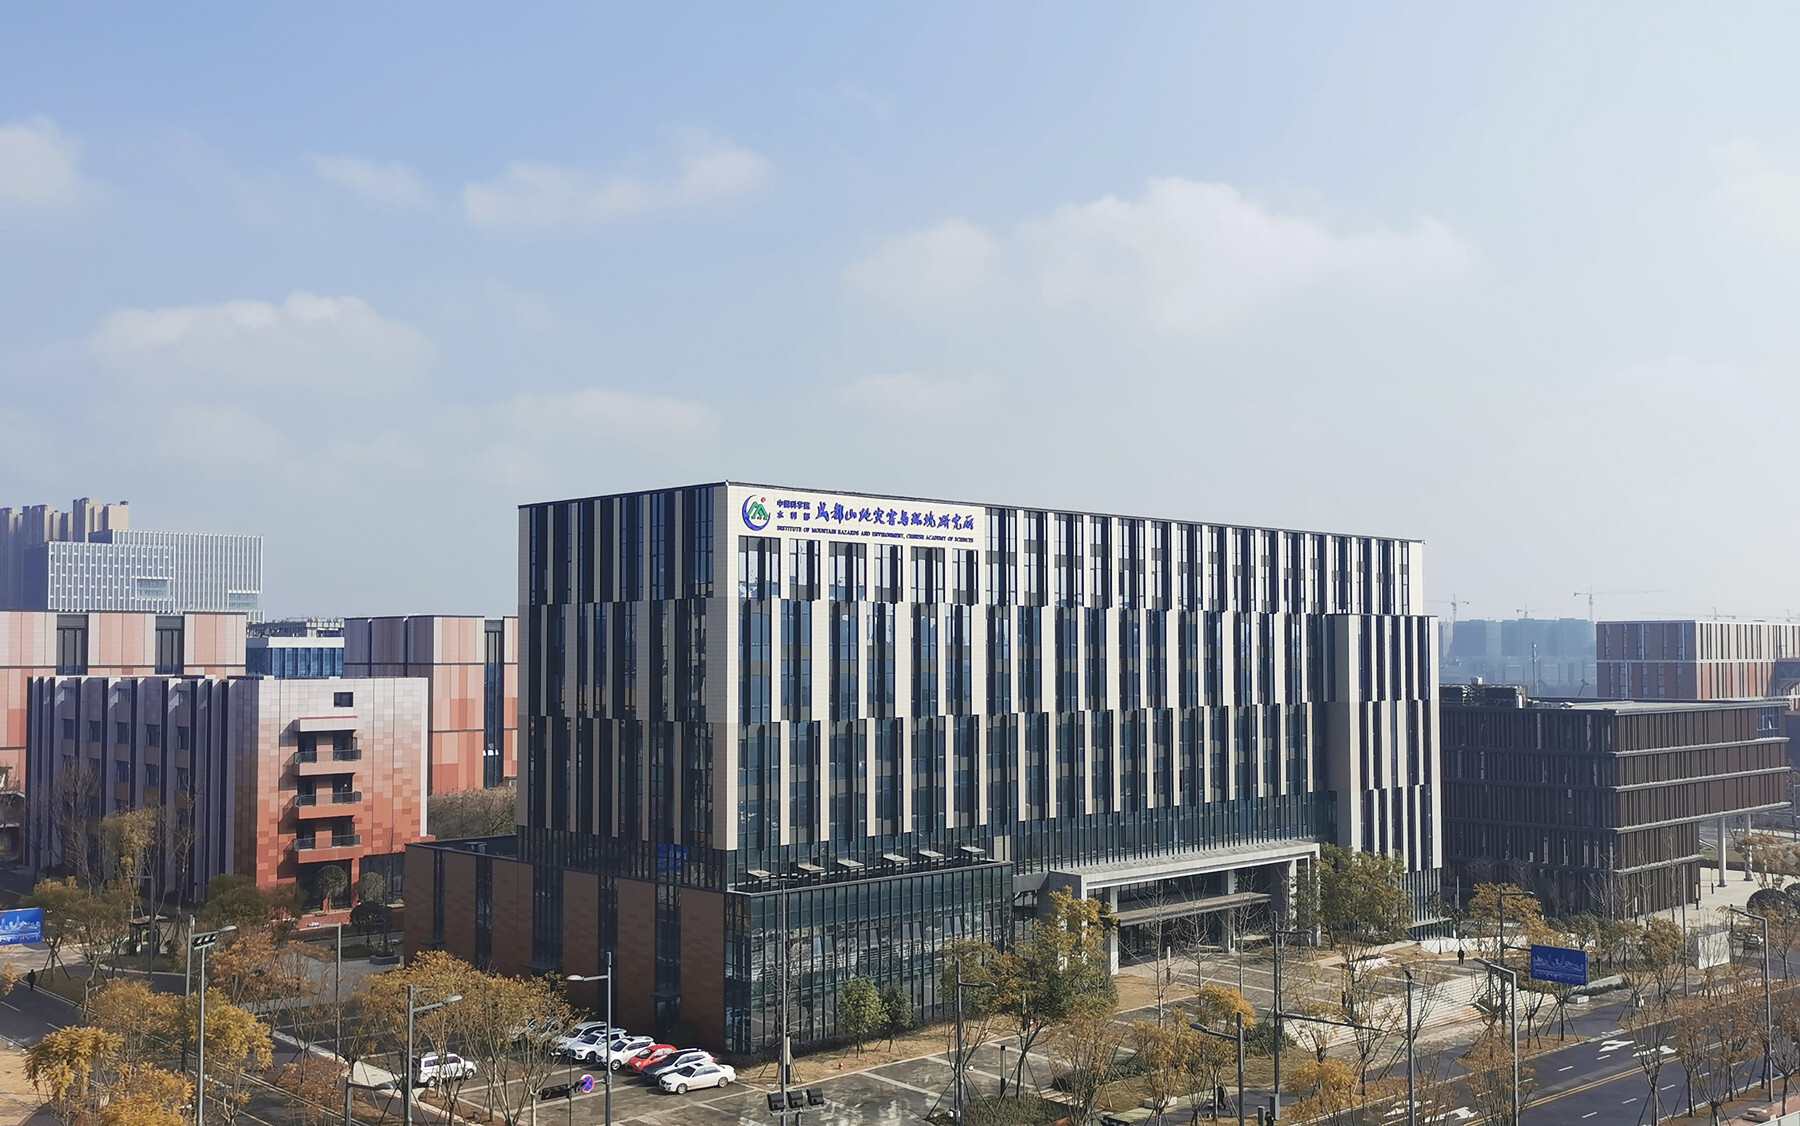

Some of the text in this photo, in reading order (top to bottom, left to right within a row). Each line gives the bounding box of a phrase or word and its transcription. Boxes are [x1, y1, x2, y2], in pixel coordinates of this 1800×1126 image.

[777, 499, 811, 510] 中国科学院
[811, 527, 836, 535] MOUNTAIN
